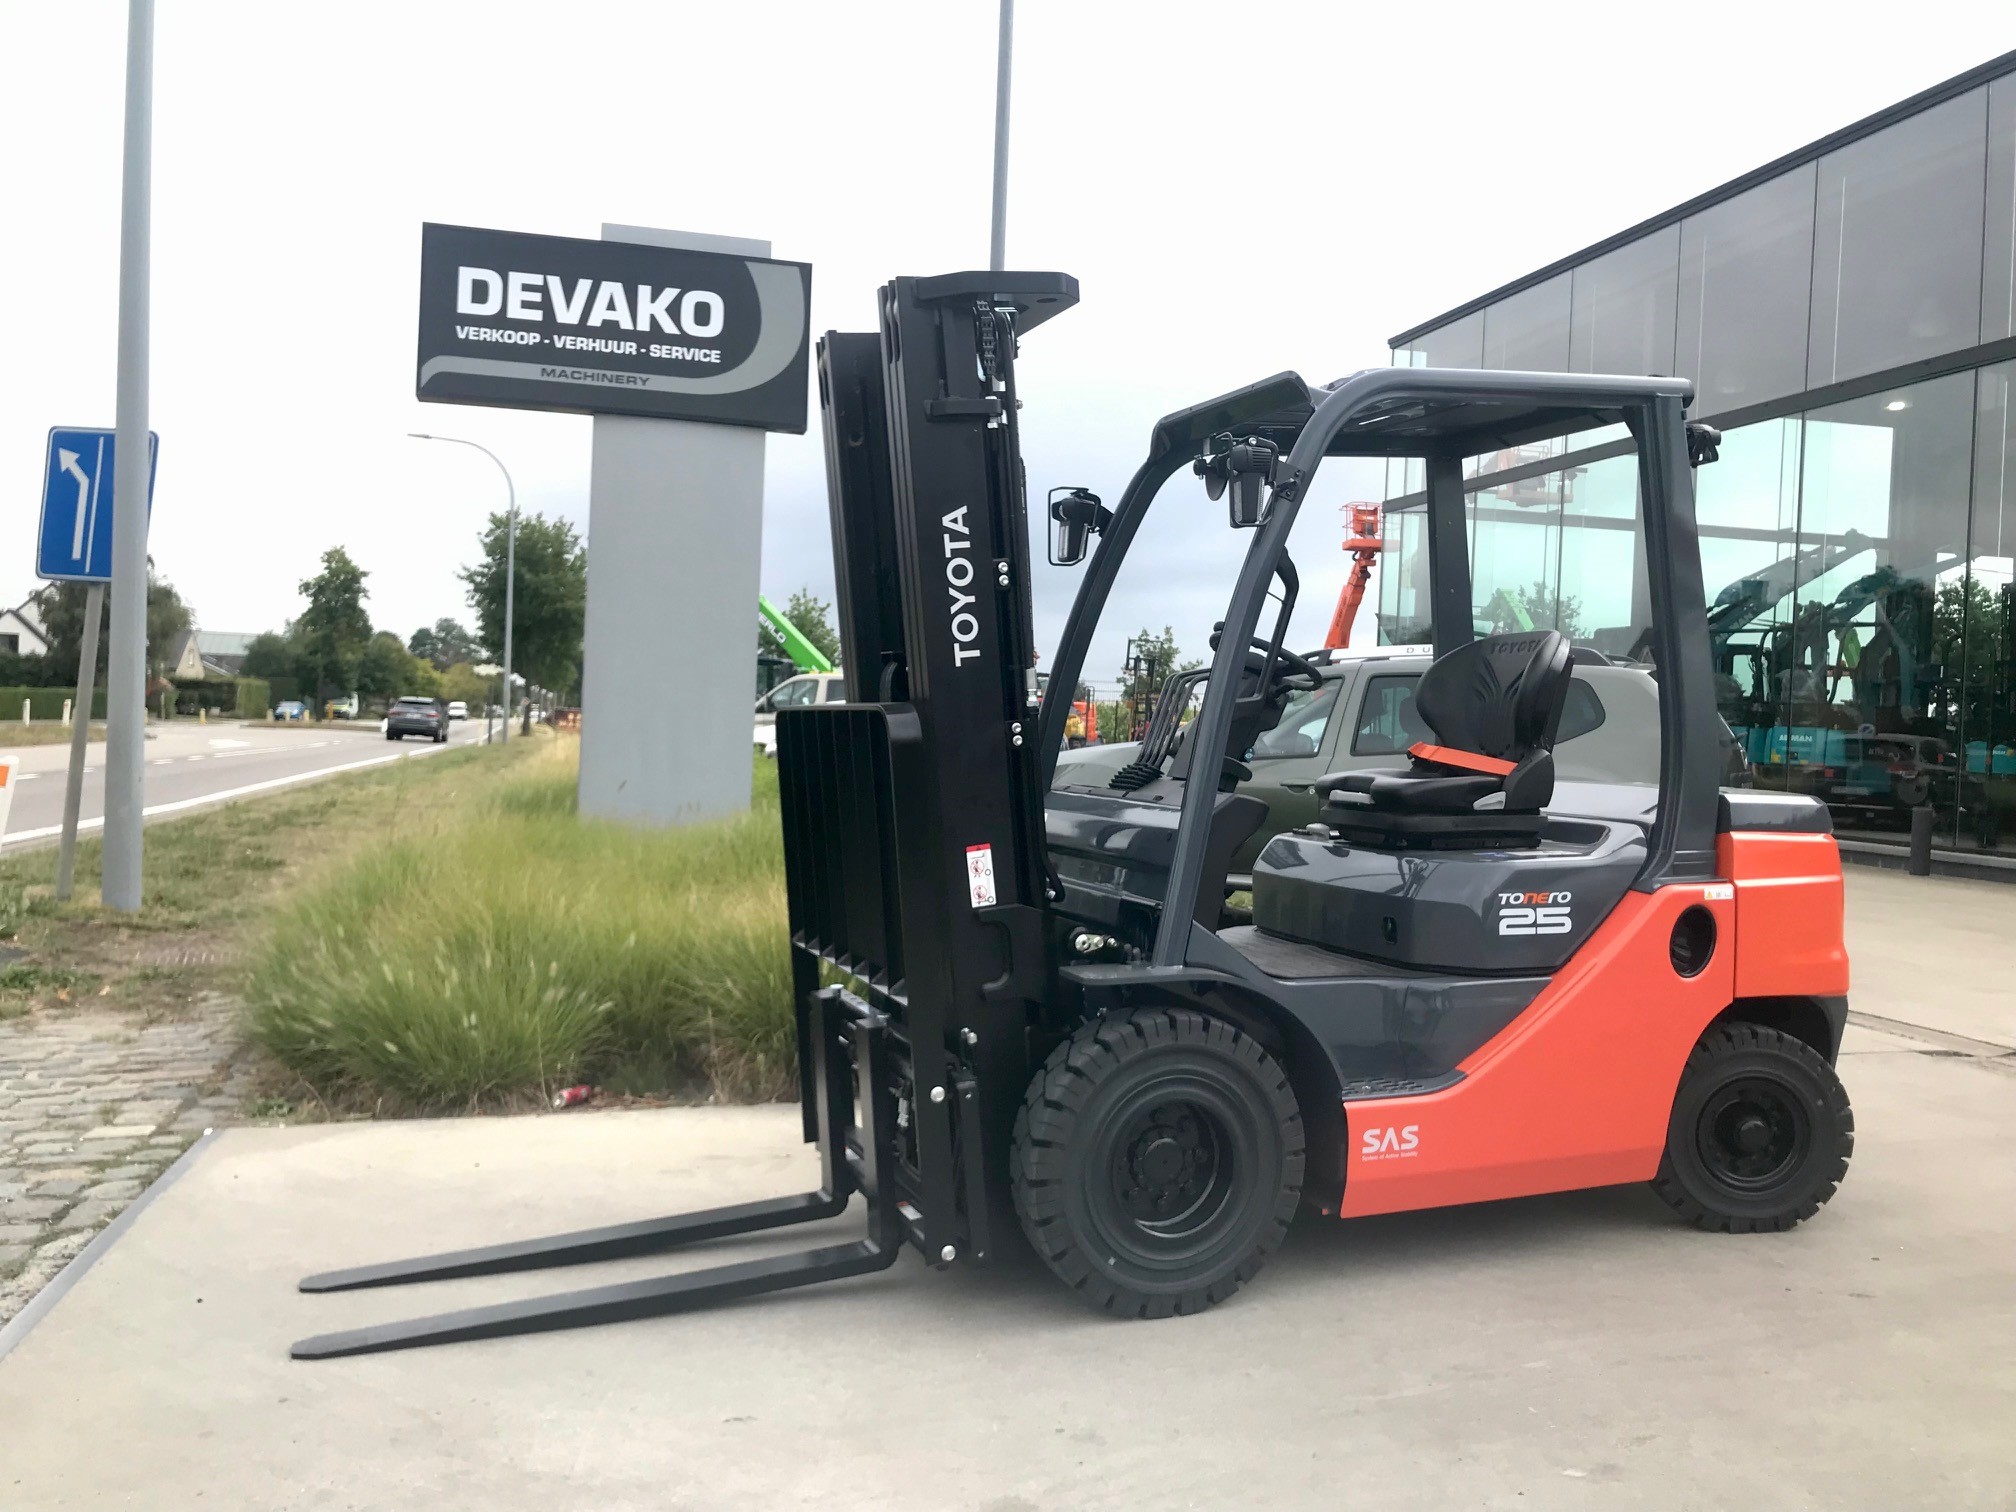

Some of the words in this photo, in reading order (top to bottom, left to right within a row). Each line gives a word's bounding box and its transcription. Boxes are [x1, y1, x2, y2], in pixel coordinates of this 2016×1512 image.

[456, 265, 725, 339] DEVAKO
[455, 324, 541, 346] VERKOOP
[553, 334, 638, 356] VERHUUR
[650, 344, 722, 364] SERVICE
[540, 367, 651, 387] MACHINERY
[942, 504, 981, 667] TOYOTA
[1498, 906, 1572, 936] 25
[1361, 1125, 1419, 1154] SAS
